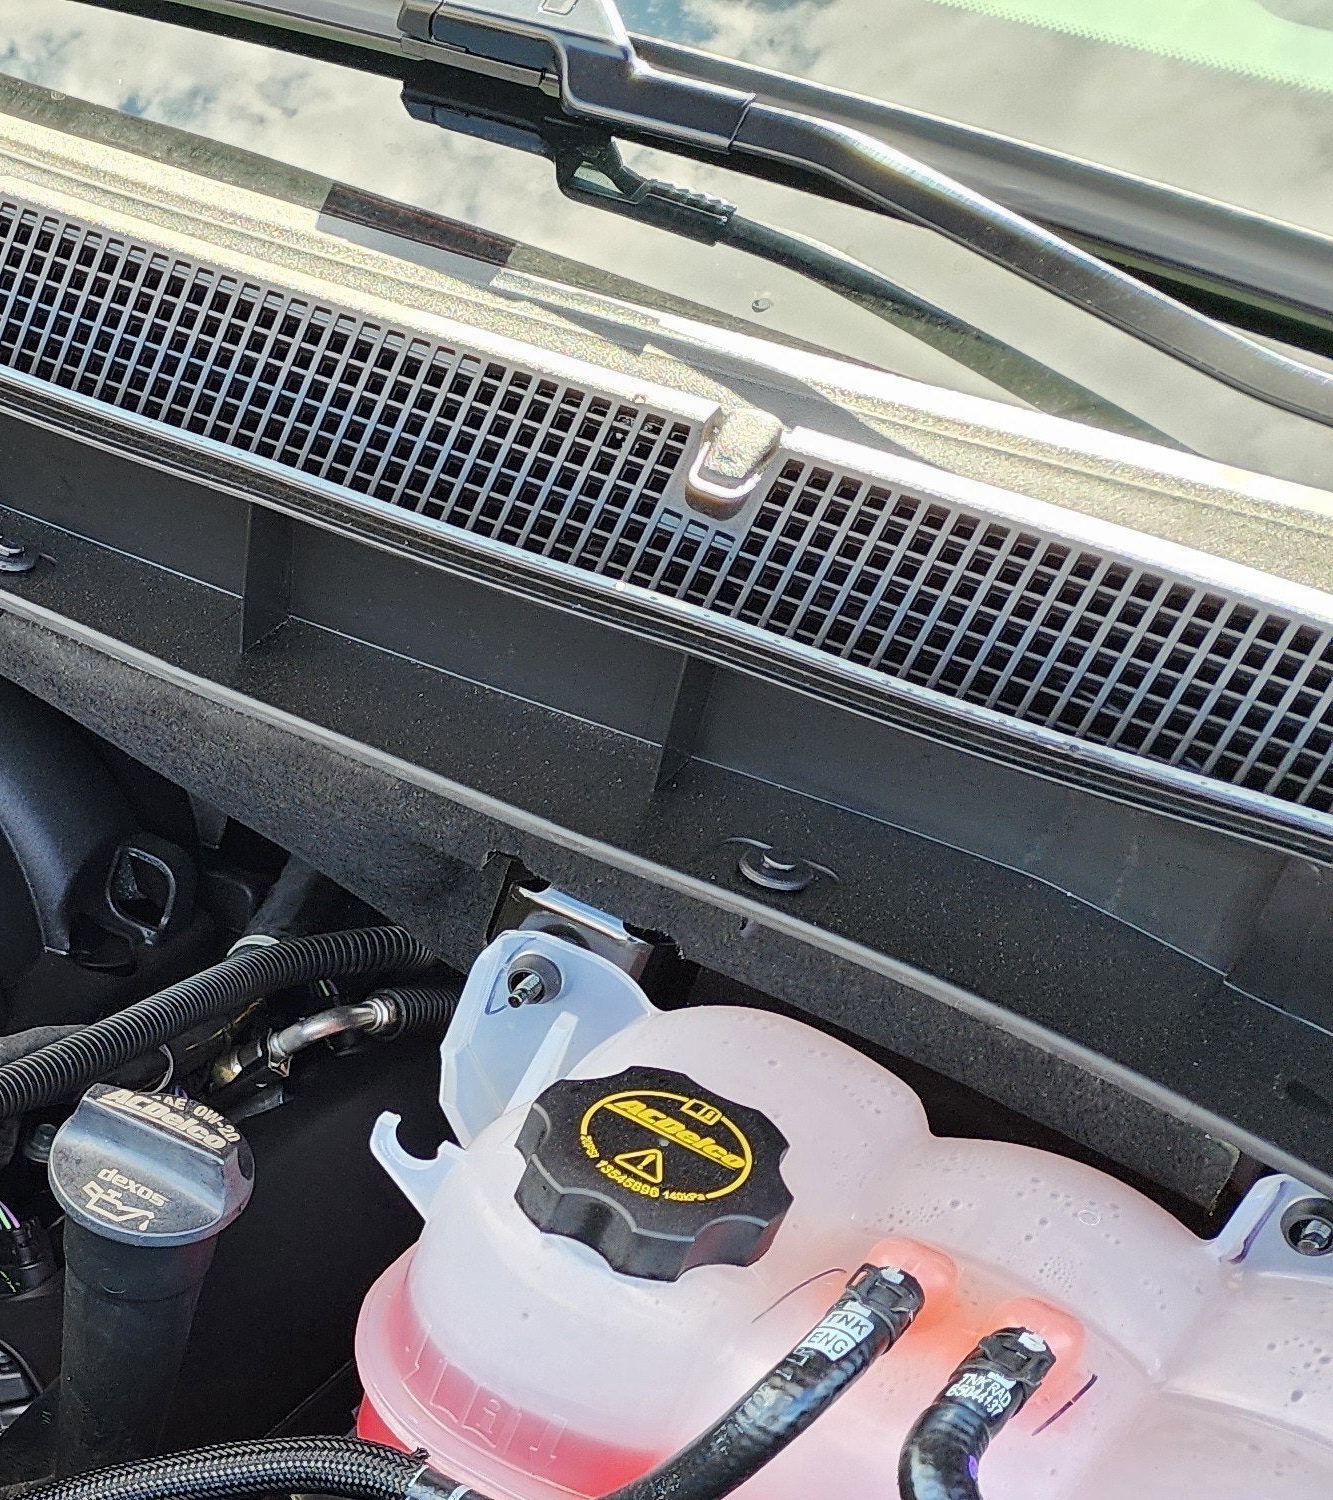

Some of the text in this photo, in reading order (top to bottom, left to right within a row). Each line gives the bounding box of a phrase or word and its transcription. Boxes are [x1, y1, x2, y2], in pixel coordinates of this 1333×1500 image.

[100, 1089, 227, 1150] ACDelco
[149, 1095, 241, 1142] AE 0W-20
[611, 1100, 746, 1168] ACDelco
[97, 1168, 170, 1207] dexos
[808, 1331, 849, 1355] ENG
[826, 1313, 869, 1336] TNK
[960, 1373, 1012, 1408] TNK RAD
